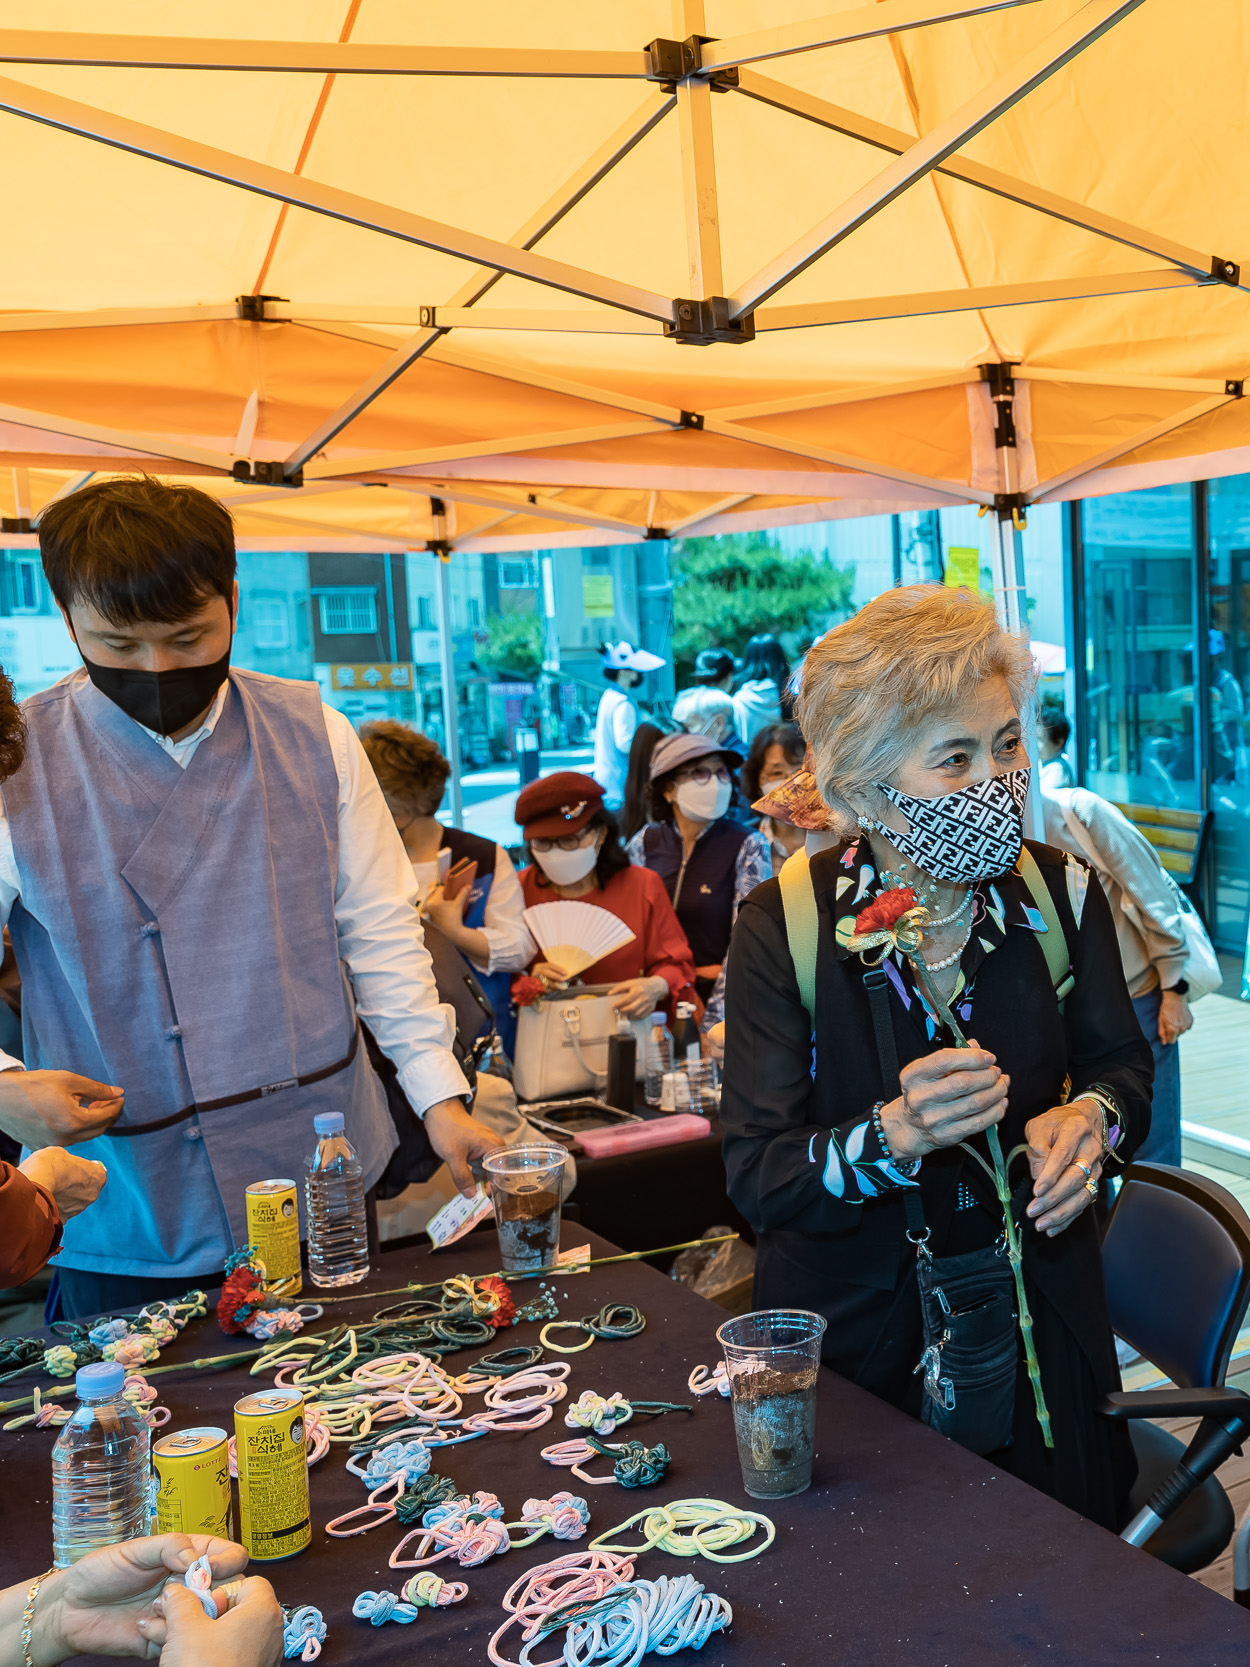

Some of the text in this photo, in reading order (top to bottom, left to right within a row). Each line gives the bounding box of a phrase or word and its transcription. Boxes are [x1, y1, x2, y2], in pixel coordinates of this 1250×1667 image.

[252, 1208, 278, 1216] 잔치집
[247, 1432, 285, 1446] 잔치집
[257, 1443, 283, 1454] 식혜
[202, 1457, 222, 1469] LOTTE
